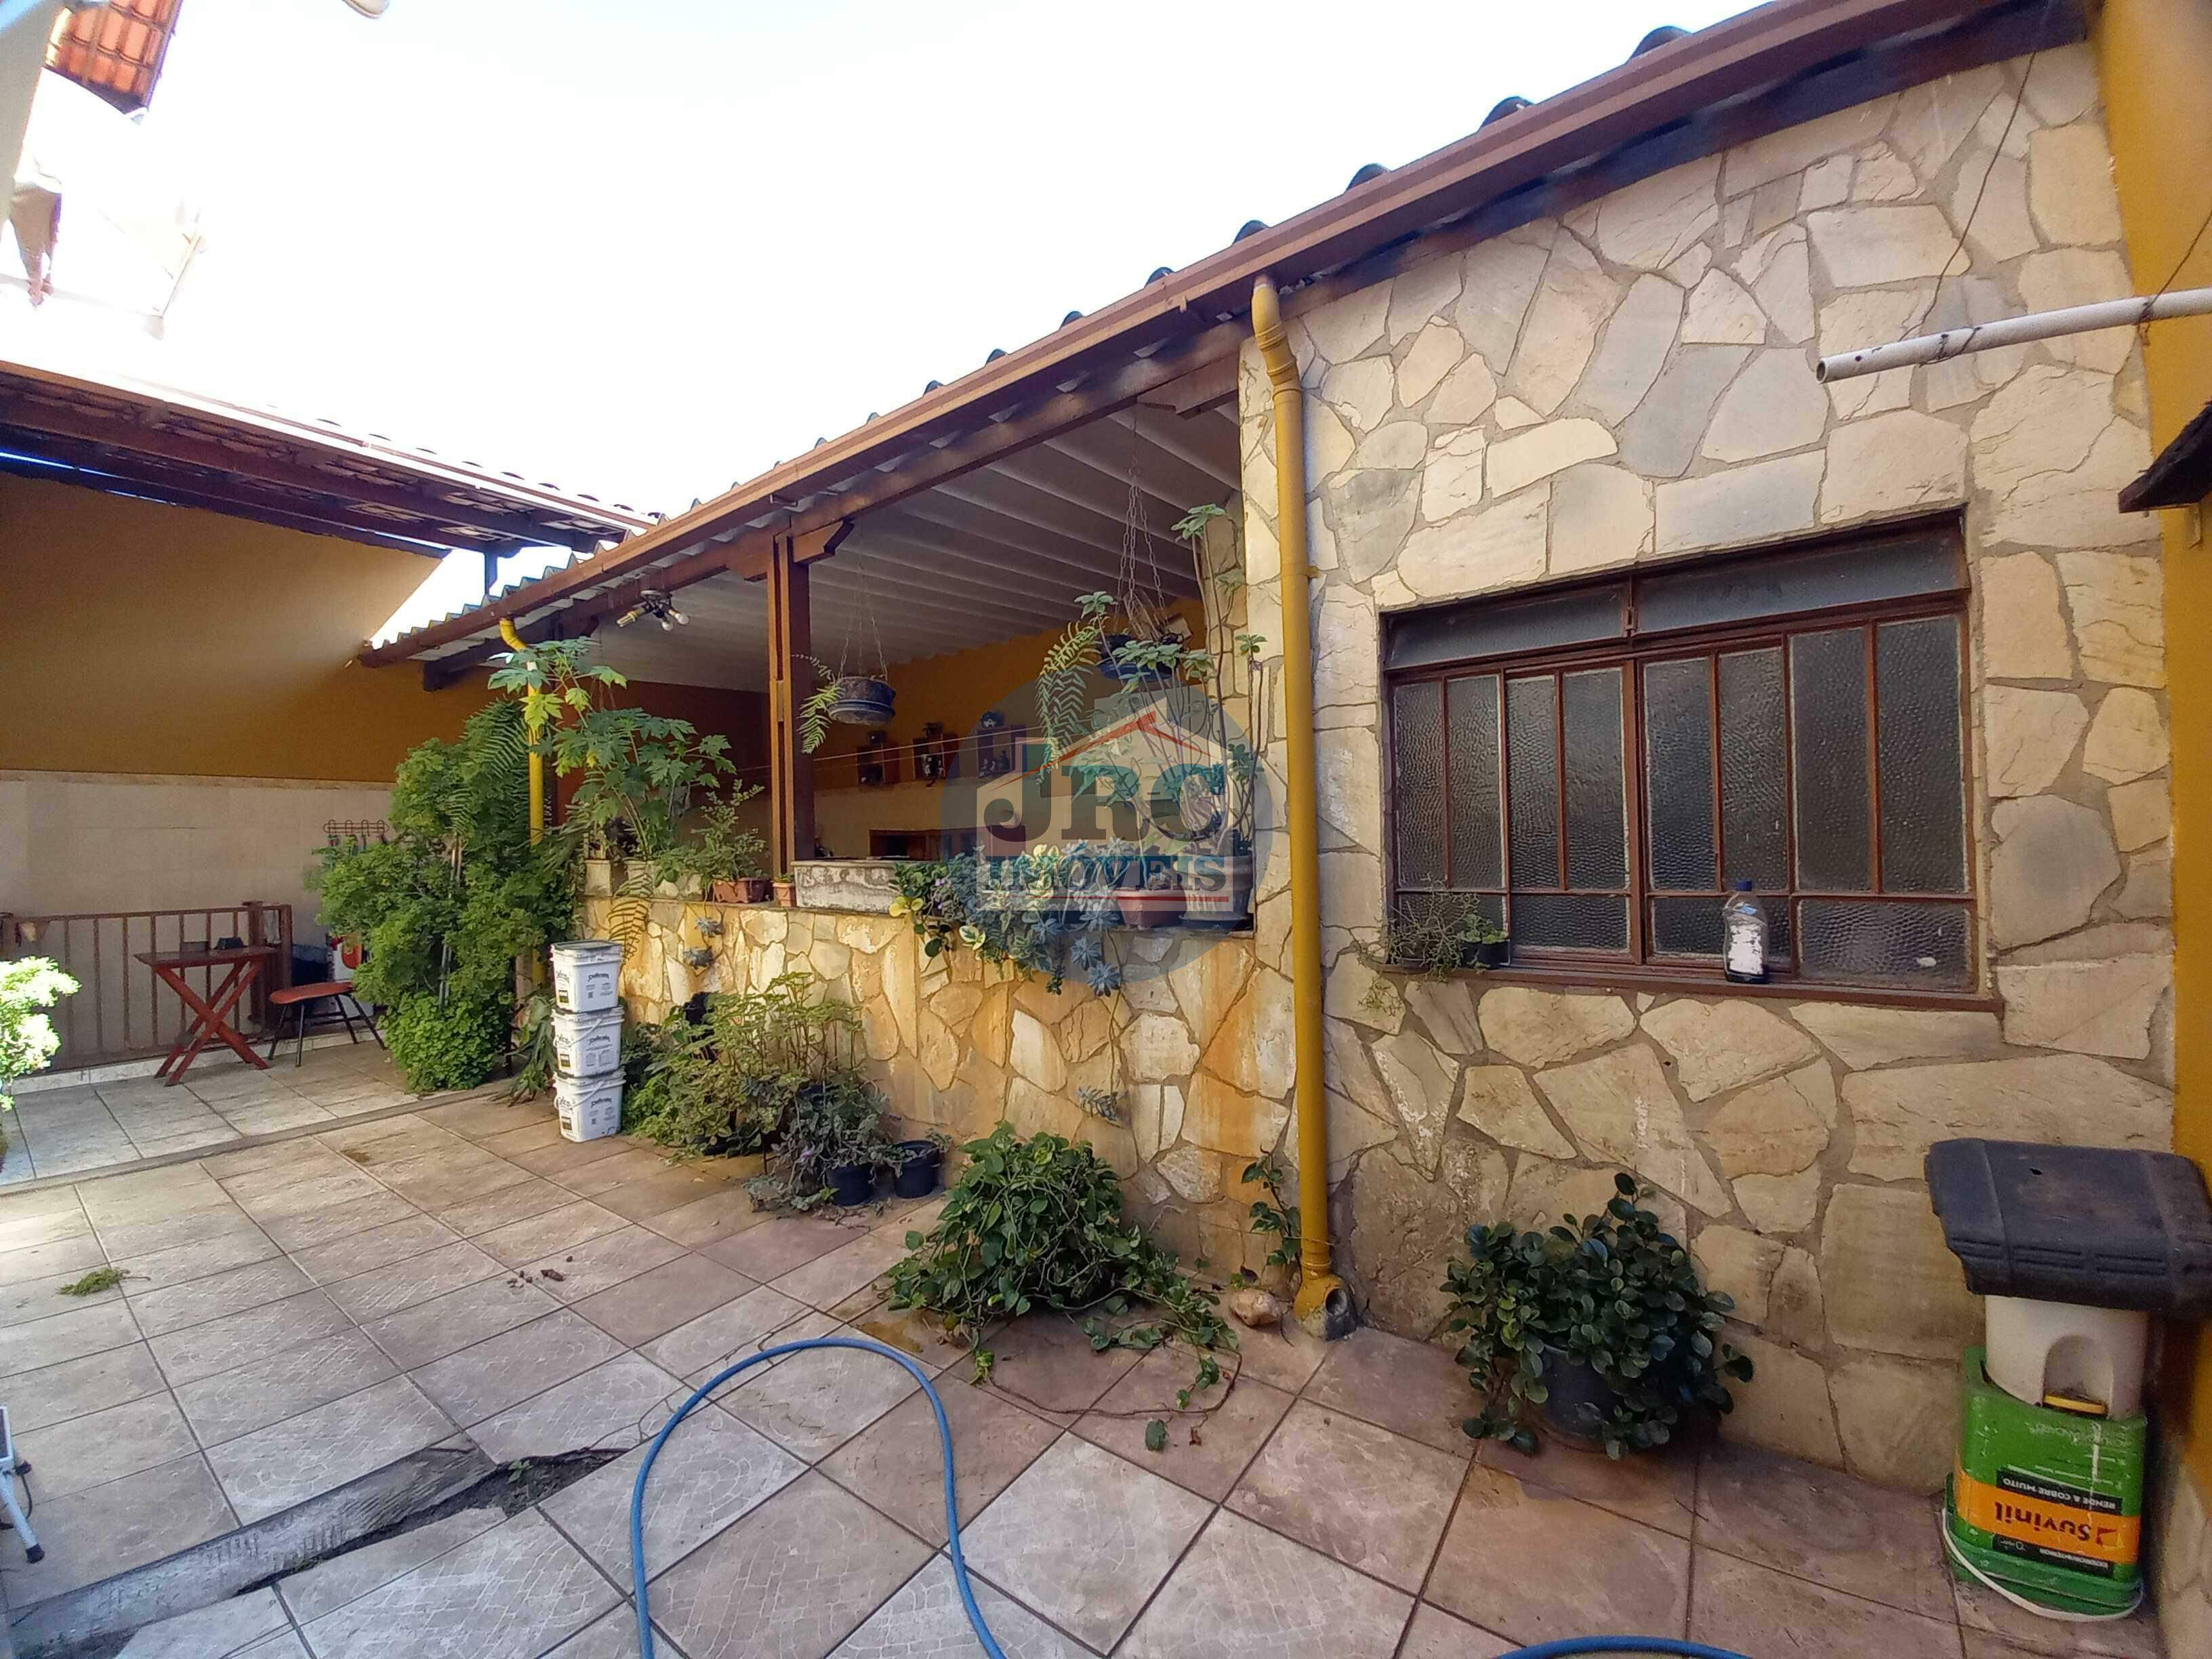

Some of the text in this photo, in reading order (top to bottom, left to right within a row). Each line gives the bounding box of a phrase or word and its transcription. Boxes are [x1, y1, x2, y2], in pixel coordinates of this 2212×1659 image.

[2003, 1477, 2036, 1492] MUITO
[2038, 1486, 2071, 1500] COBRE
[2083, 1496, 2116, 1510] RENDE
[1994, 1502, 2091, 1541] Suvinil
